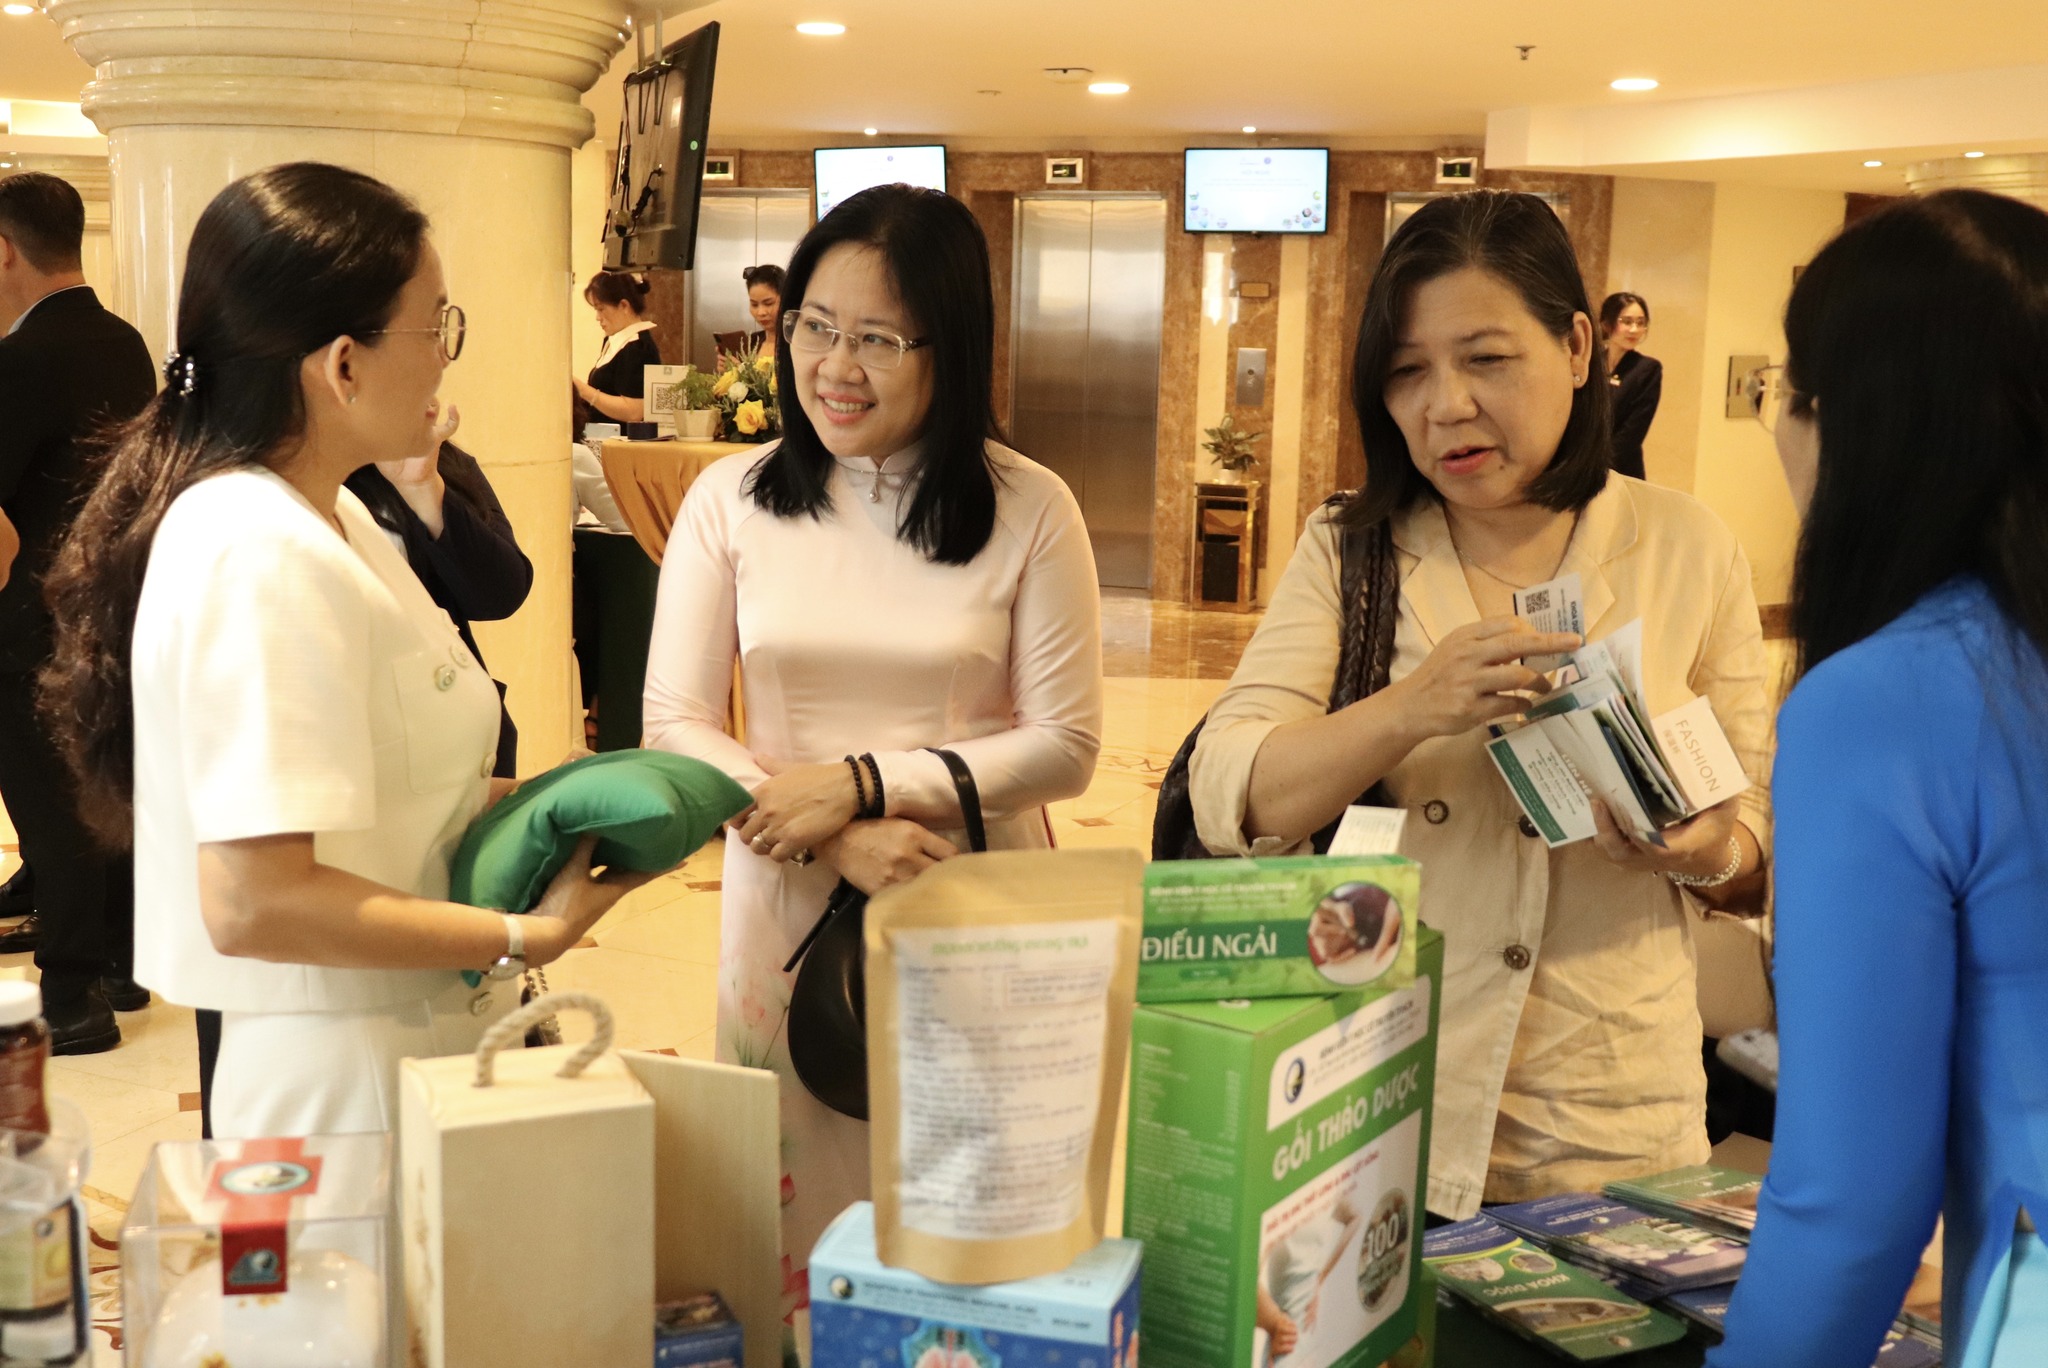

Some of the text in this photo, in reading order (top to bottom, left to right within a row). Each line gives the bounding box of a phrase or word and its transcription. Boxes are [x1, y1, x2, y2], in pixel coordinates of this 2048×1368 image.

[1675, 719, 1721, 792] FASHION
[1211, 924, 1277, 958] NGẢI
[1272, 1062, 1420, 1181] GỐI THẢO DƯỢC
[1525, 1273, 1571, 1289] KHOA
